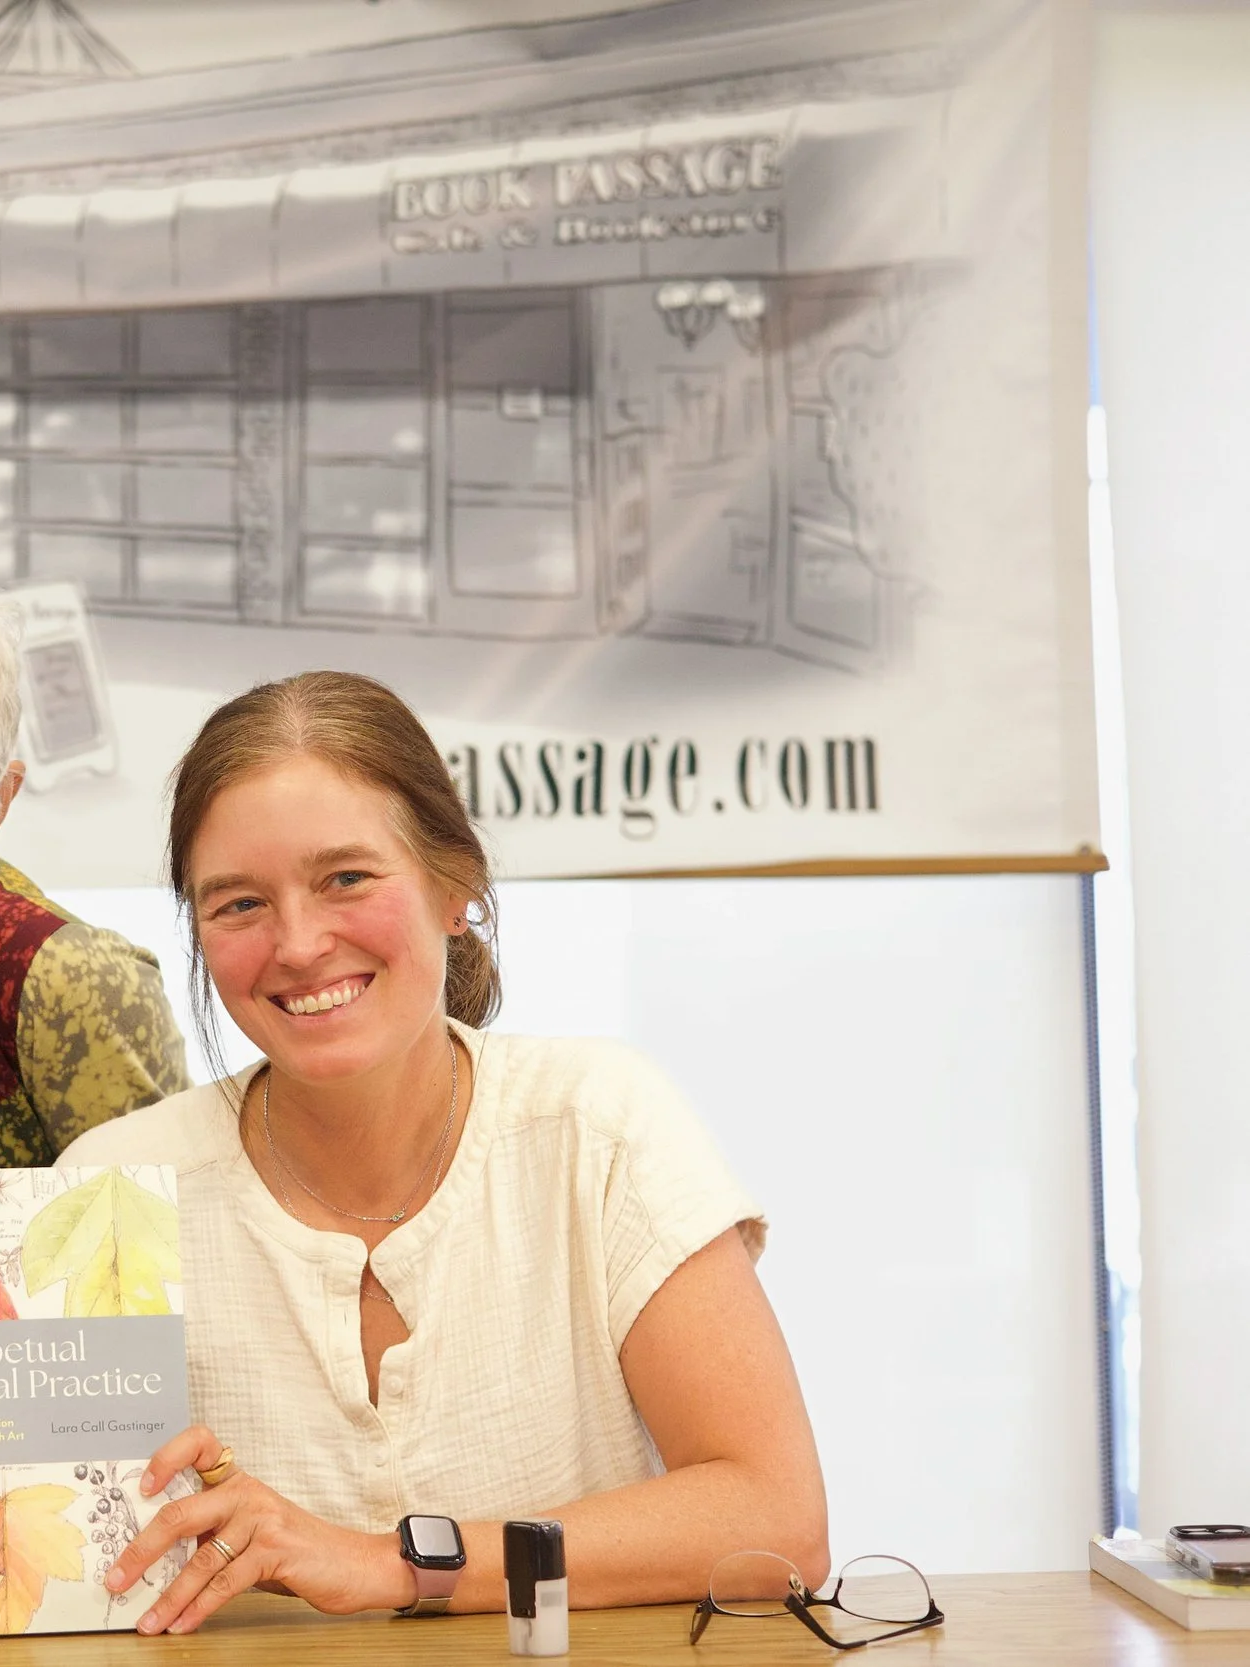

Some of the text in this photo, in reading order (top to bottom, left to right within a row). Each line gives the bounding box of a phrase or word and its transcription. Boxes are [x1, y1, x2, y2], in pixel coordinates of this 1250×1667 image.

[392, 139, 784, 222] BOOK PASSAGE
[449, 735, 882, 842] assage.com
[29, 1368, 163, 1399] Practice
[7, 1430, 25, 1441] Art
[51, 1419, 166, 1434] Lara Call Gastinger
